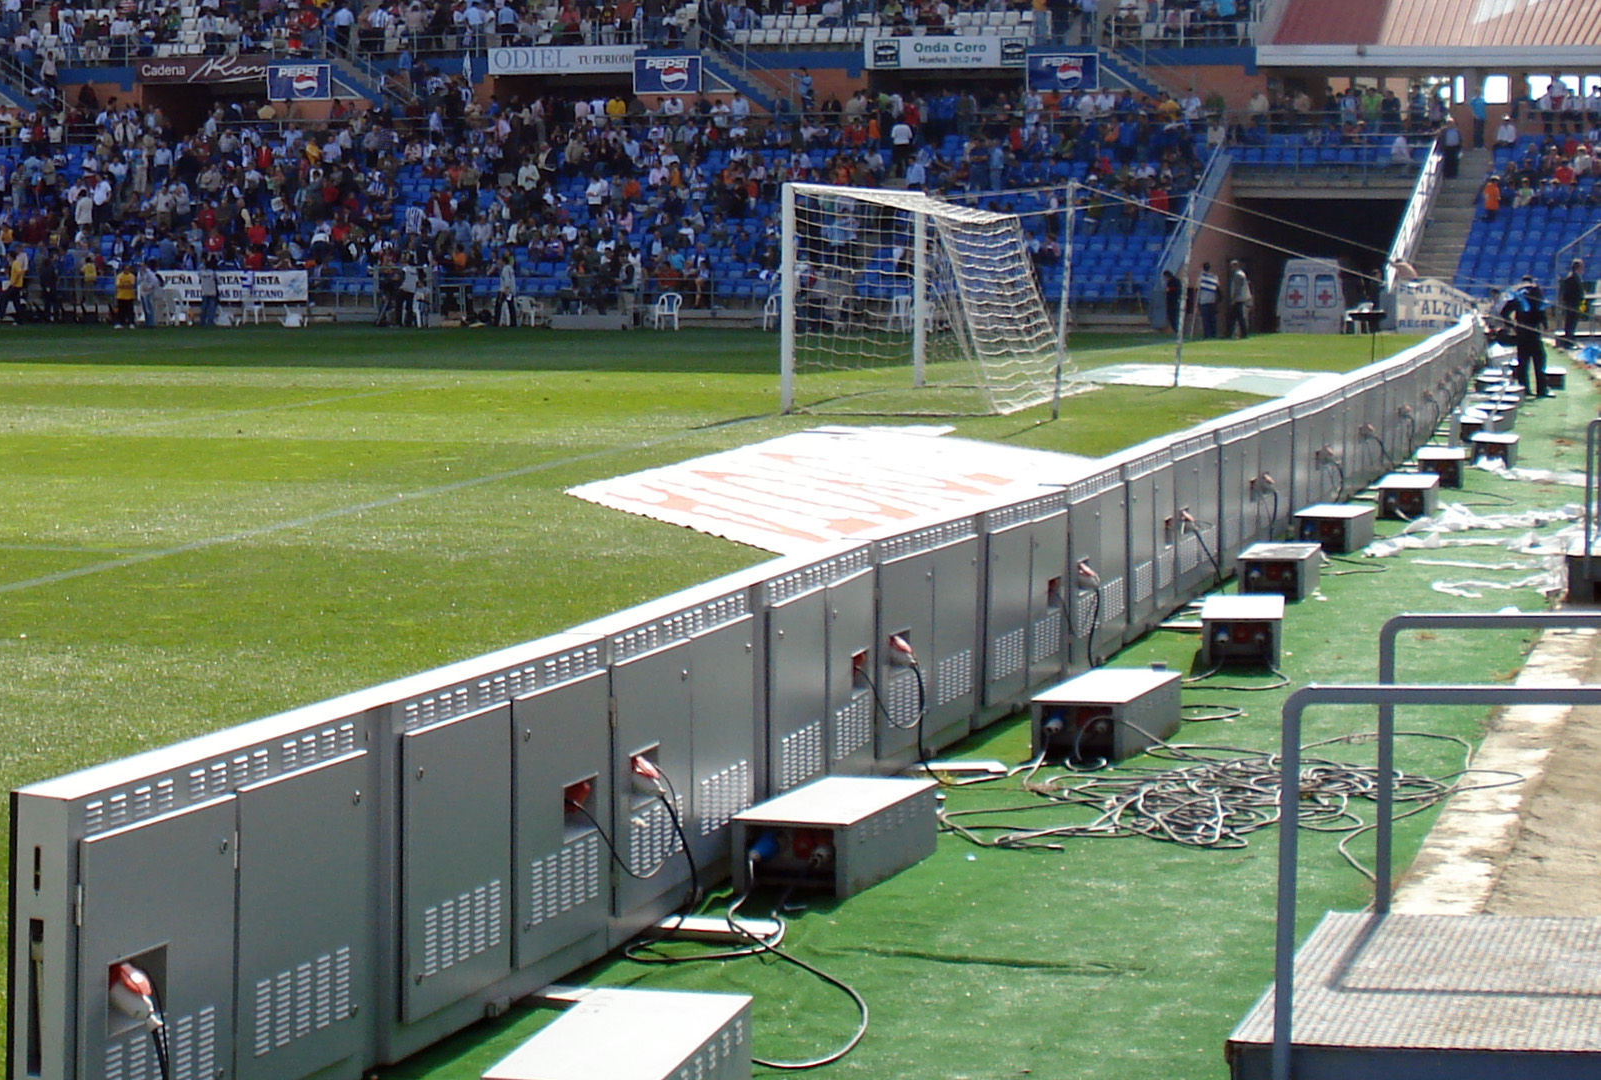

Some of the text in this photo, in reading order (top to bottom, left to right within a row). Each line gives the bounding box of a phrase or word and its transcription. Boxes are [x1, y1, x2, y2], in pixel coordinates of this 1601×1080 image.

[913, 41, 987, 54] Onda Cero
[493, 48, 570, 69] ODIEL
[577, 55, 591, 65] TU
[645, 58, 689, 70] PEPSI
[141, 64, 186, 77] Cadena
[278, 67, 319, 78] PEPSI
[164, 274, 193, 285] PEÑA
